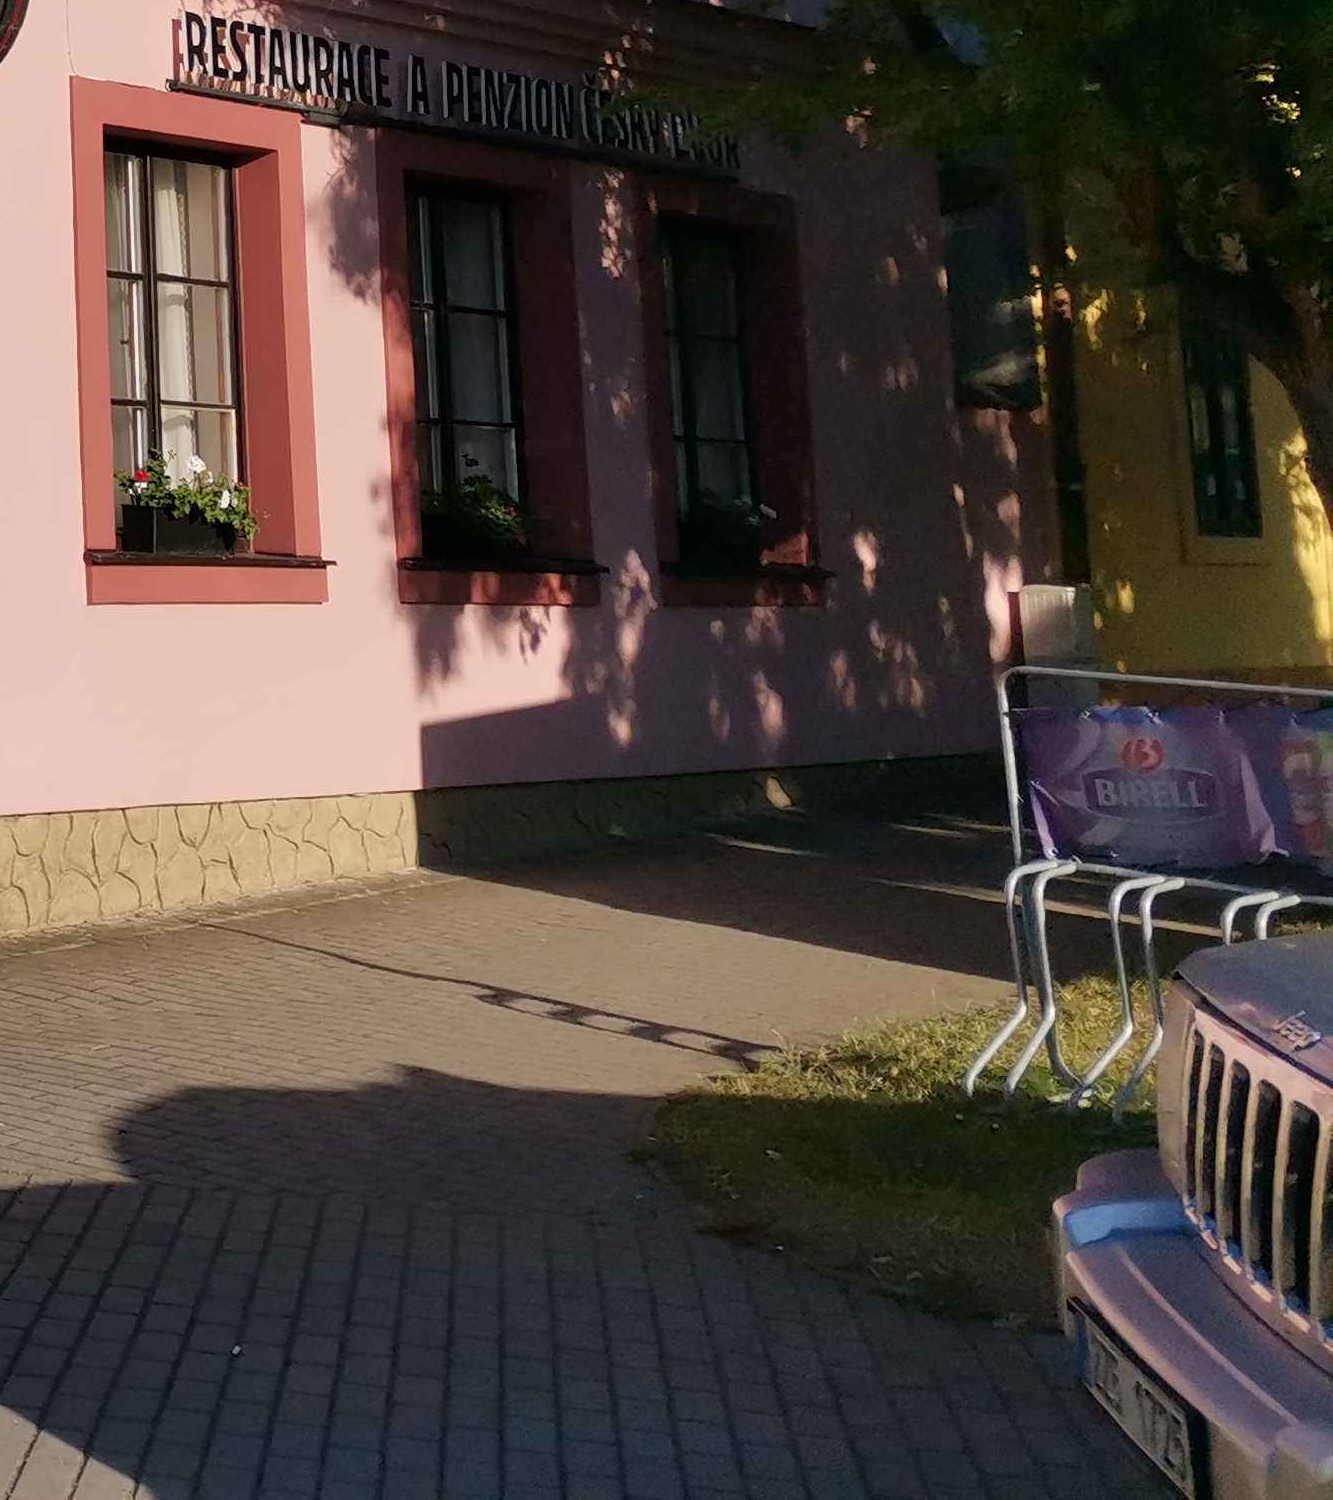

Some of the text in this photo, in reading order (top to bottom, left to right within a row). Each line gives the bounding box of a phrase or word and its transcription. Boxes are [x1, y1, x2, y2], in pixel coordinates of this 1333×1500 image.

[183, 11, 392, 108] RESTAURACE
[407, 54, 431, 116] A
[441, 60, 574, 140] PENZION
[1095, 779, 1207, 808] BIRELL
[1272, 1010, 1322, 1049] Jeep
